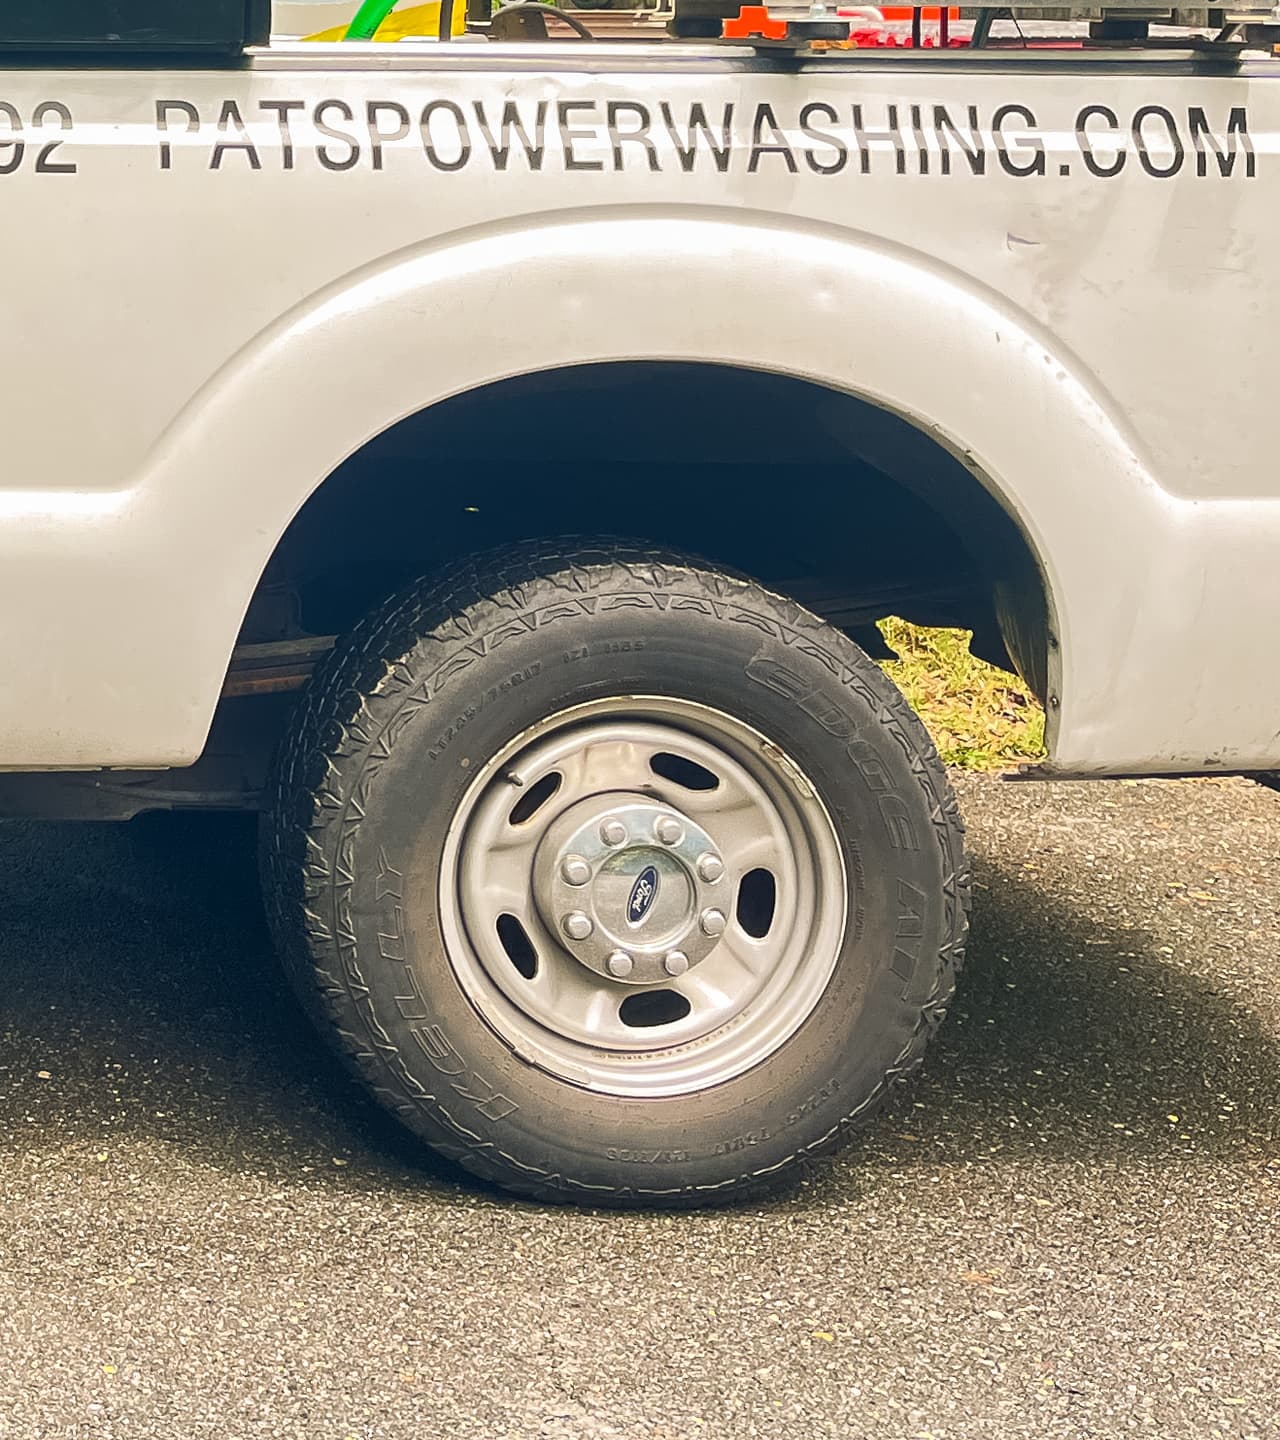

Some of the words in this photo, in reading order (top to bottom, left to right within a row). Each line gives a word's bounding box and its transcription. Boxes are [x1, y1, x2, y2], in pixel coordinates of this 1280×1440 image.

[155, 99, 1257, 178] PATSPOWERWASHING.COM
[745, 657, 921, 851] EDGE
[632, 879, 653, 913] Ford
[375, 844, 521, 1122] KELLY
